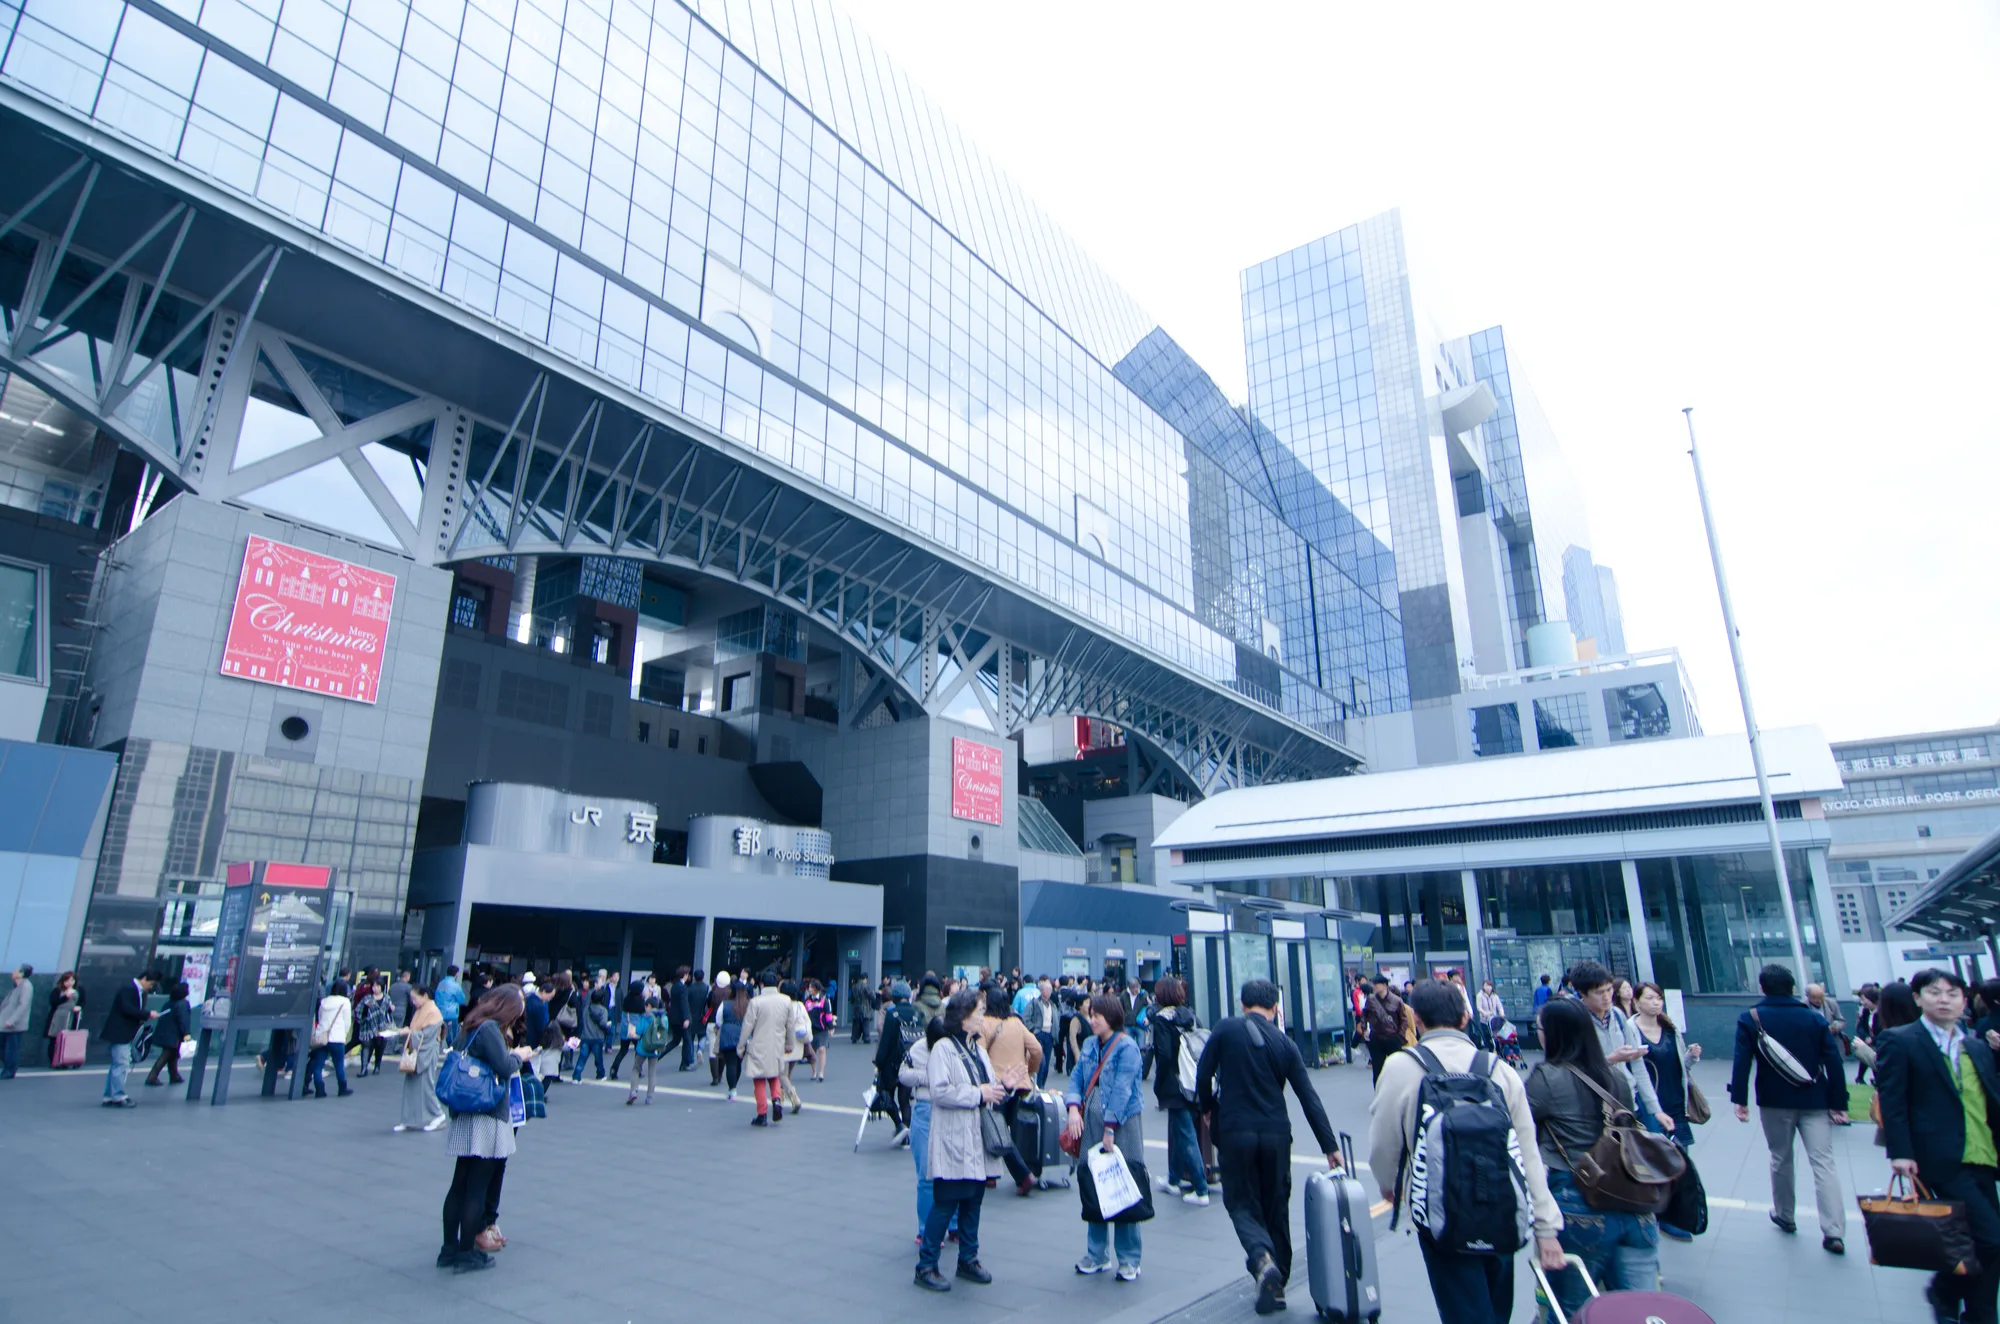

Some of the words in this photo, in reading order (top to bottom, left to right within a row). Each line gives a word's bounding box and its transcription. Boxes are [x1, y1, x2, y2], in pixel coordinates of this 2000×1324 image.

[245, 592, 377, 653] Christmas
[348, 626, 376, 640] Merry
[262, 634, 279, 645] The
[303, 643, 314, 652] of
[315, 646, 329, 656] the
[331, 649, 354, 661] heart
[1864, 794, 1922, 809] CENTRAL
[1925, 791, 1960, 804] POST
[571, 806, 602, 827] JR
[774, 847, 801, 862] Kyoto
[803, 850, 835, 865] Station
